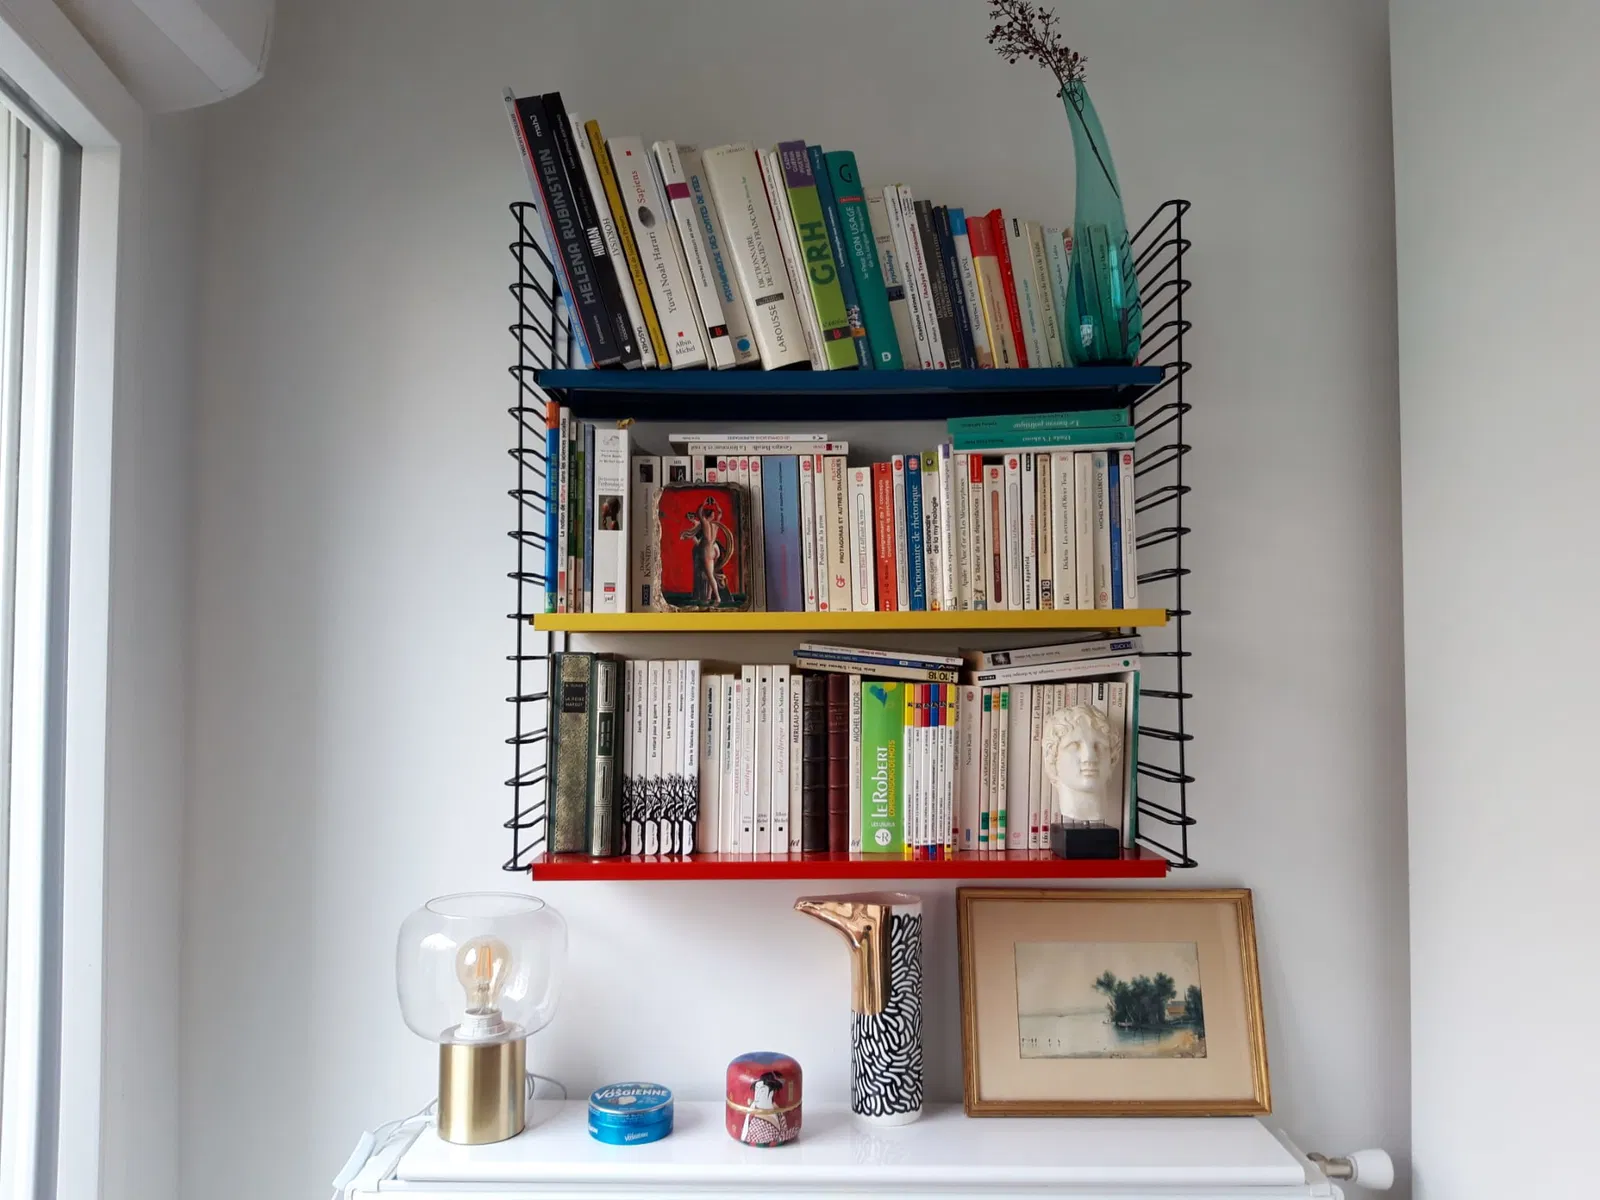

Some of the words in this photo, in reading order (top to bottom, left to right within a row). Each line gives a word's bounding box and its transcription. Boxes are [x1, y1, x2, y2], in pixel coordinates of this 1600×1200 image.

[537, 146, 577, 240] RUBINSTEIN
[628, 169, 648, 204] Sapiens
[844, 205, 859, 235] USAGE
[586, 226, 605, 257] HUMAN
[601, 217, 620, 256] HOKUSAI
[645, 230, 663, 261] Harari
[851, 235, 864, 256] BON
[909, 222, 924, 271] Transactionnelle
[745, 234, 765, 288] DICTIONNAIRE
[798, 218, 837, 287] GRH
[566, 242, 596, 305] HELENA
[655, 262, 669, 287] Noah
[918, 272, 930, 299] l'Analyse
[662, 288, 677, 313] Yuval
[909, 293, 918, 313] latines
[635, 325, 649, 353] TASCHEN
[768, 304, 787, 353] LAROUSSE
[913, 313, 924, 341] Citations
[675, 346, 696, 356] Michel
[909, 484, 921, 529] rhétorique
[930, 496, 939, 535] mythologie
[911, 531, 920, 541] de
[642, 543, 651, 577] KENNEDY
[911, 543, 922, 597] Dictionnaire
[835, 573, 845, 587] GF
[927, 671, 937, 680] 18
[938, 672, 949, 681] 10
[594, 1088, 669, 1100] VOSGIENNE
